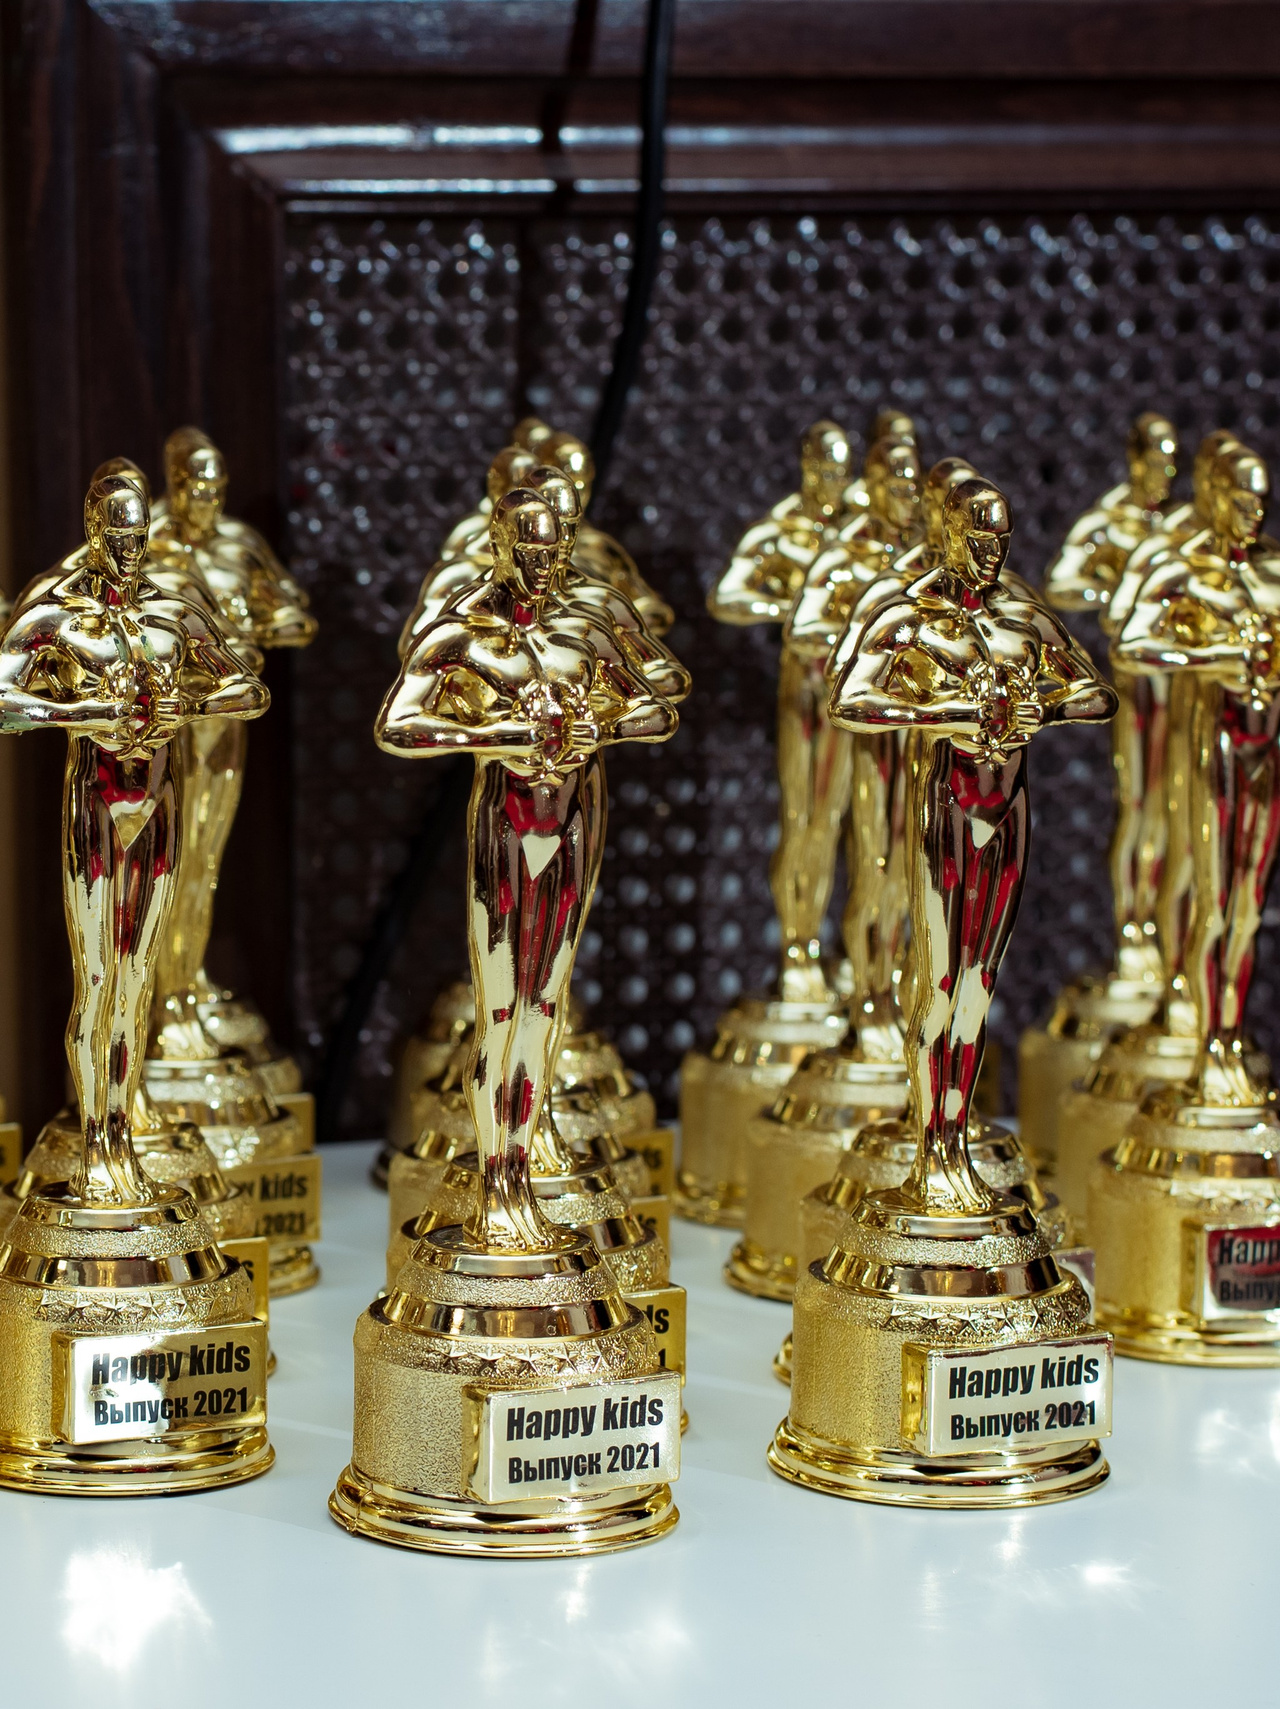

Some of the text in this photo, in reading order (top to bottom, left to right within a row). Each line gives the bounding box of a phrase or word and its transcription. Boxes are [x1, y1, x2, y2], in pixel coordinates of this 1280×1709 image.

[260, 1172, 308, 1202] kids
[263, 1211, 306, 1236] 2021
[1218, 1238, 1280, 1266] Happ
[91, 1341, 251, 1385] Happy kids
[949, 1354, 1100, 1399] Happy kids
[94, 1387, 248, 1426] Выпуск 2021
[506, 1394, 664, 1441] Happy kids
[950, 1400, 1096, 1440] Выпуск 2021
[508, 1442, 661, 1484] Выпуск 2021
